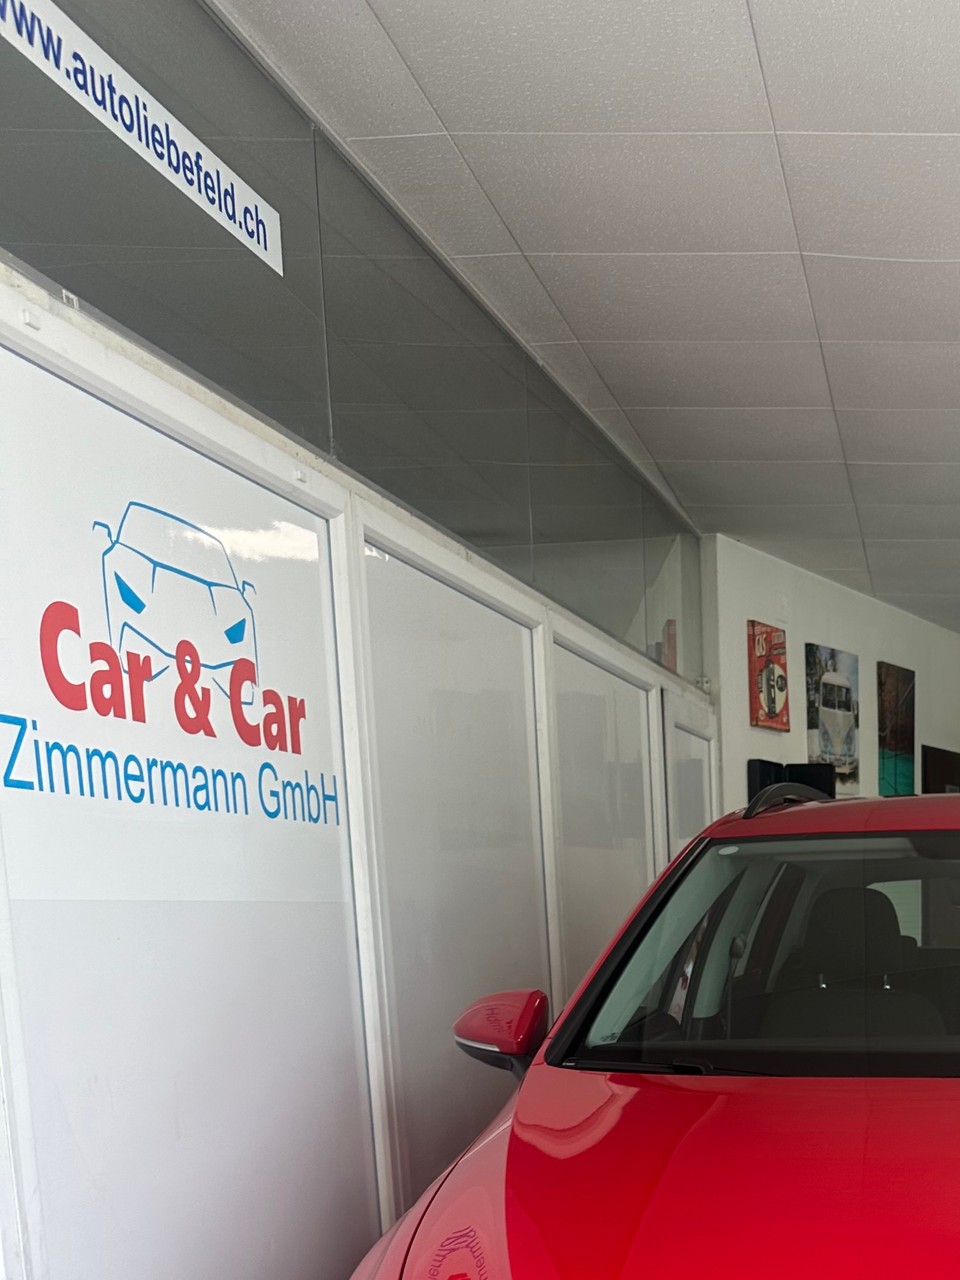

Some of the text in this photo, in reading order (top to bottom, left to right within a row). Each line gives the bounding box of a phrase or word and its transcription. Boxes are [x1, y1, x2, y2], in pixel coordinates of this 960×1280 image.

[0, 0, 267, 251] ww.autoliebefeld.ch
[40, 601, 307, 755] Car & Car
[0, 713, 340, 826] Zimmermann GmbH
